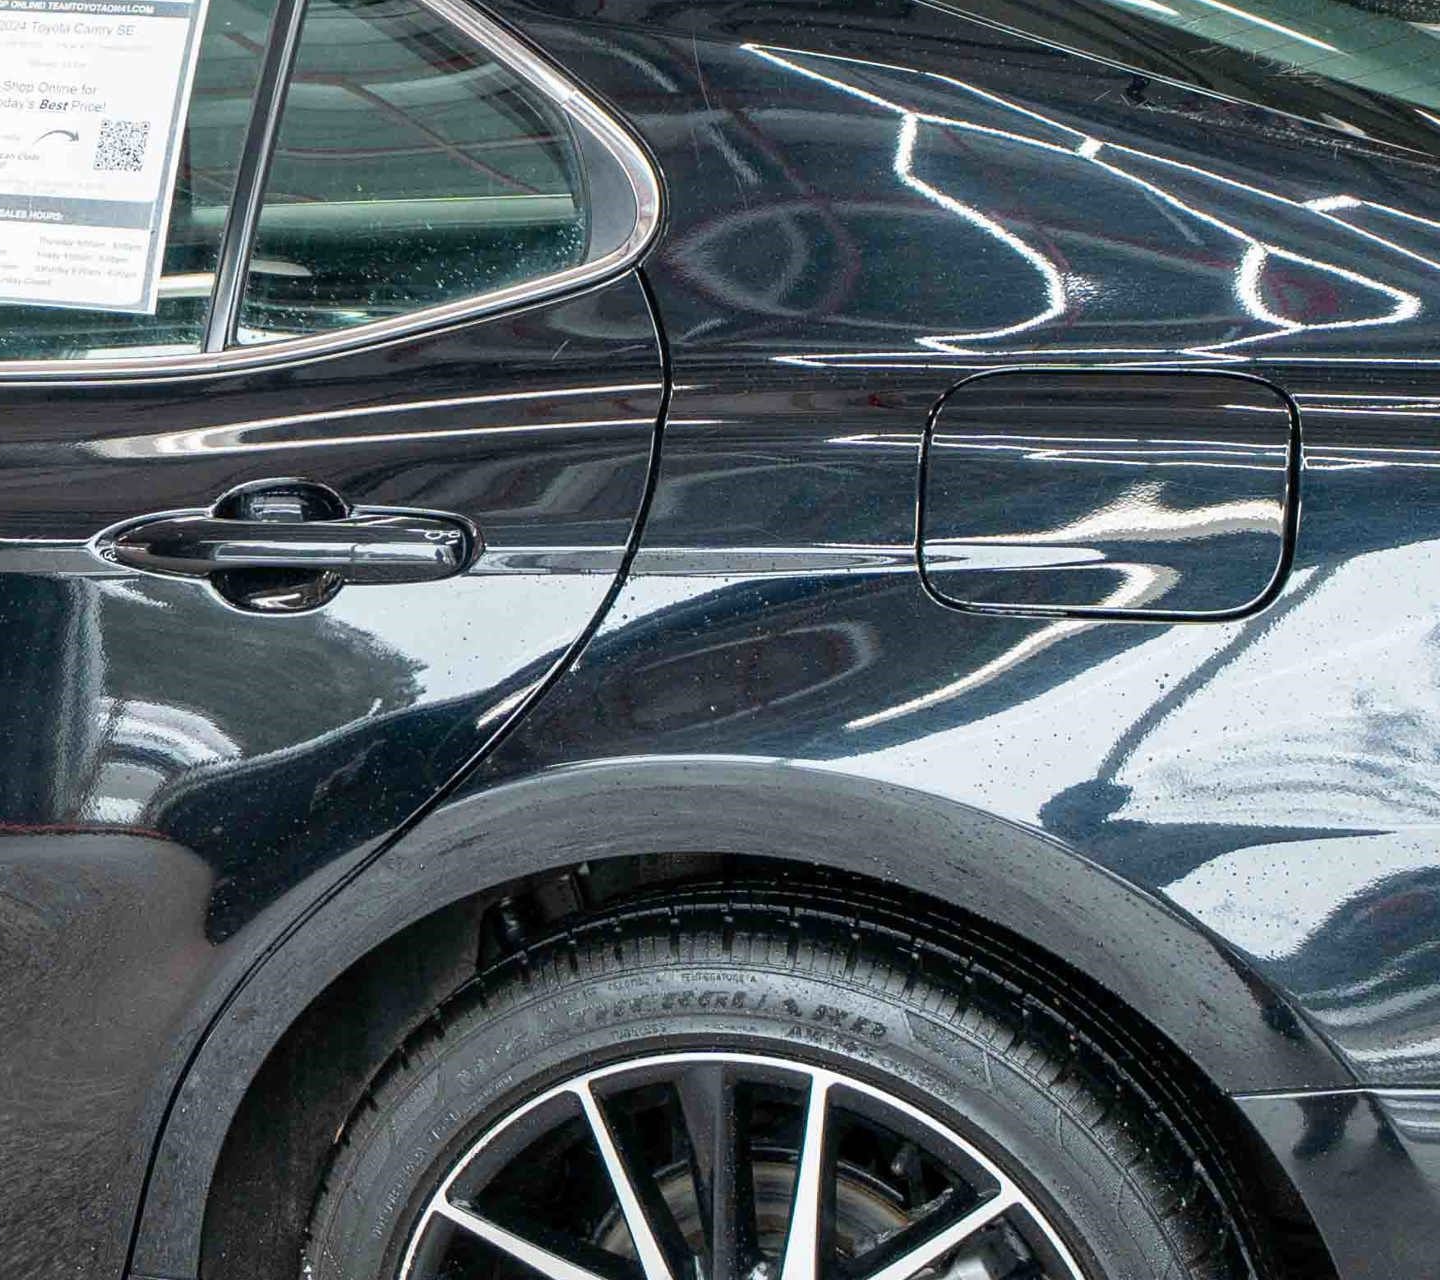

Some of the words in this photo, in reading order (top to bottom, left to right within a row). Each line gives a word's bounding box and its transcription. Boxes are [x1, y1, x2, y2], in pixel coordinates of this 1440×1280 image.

[31, 20, 70, 35] Toyota
[80, 82, 97, 96] for
[39, 99, 69, 112] Best
[70, 99, 107, 113] Price!
